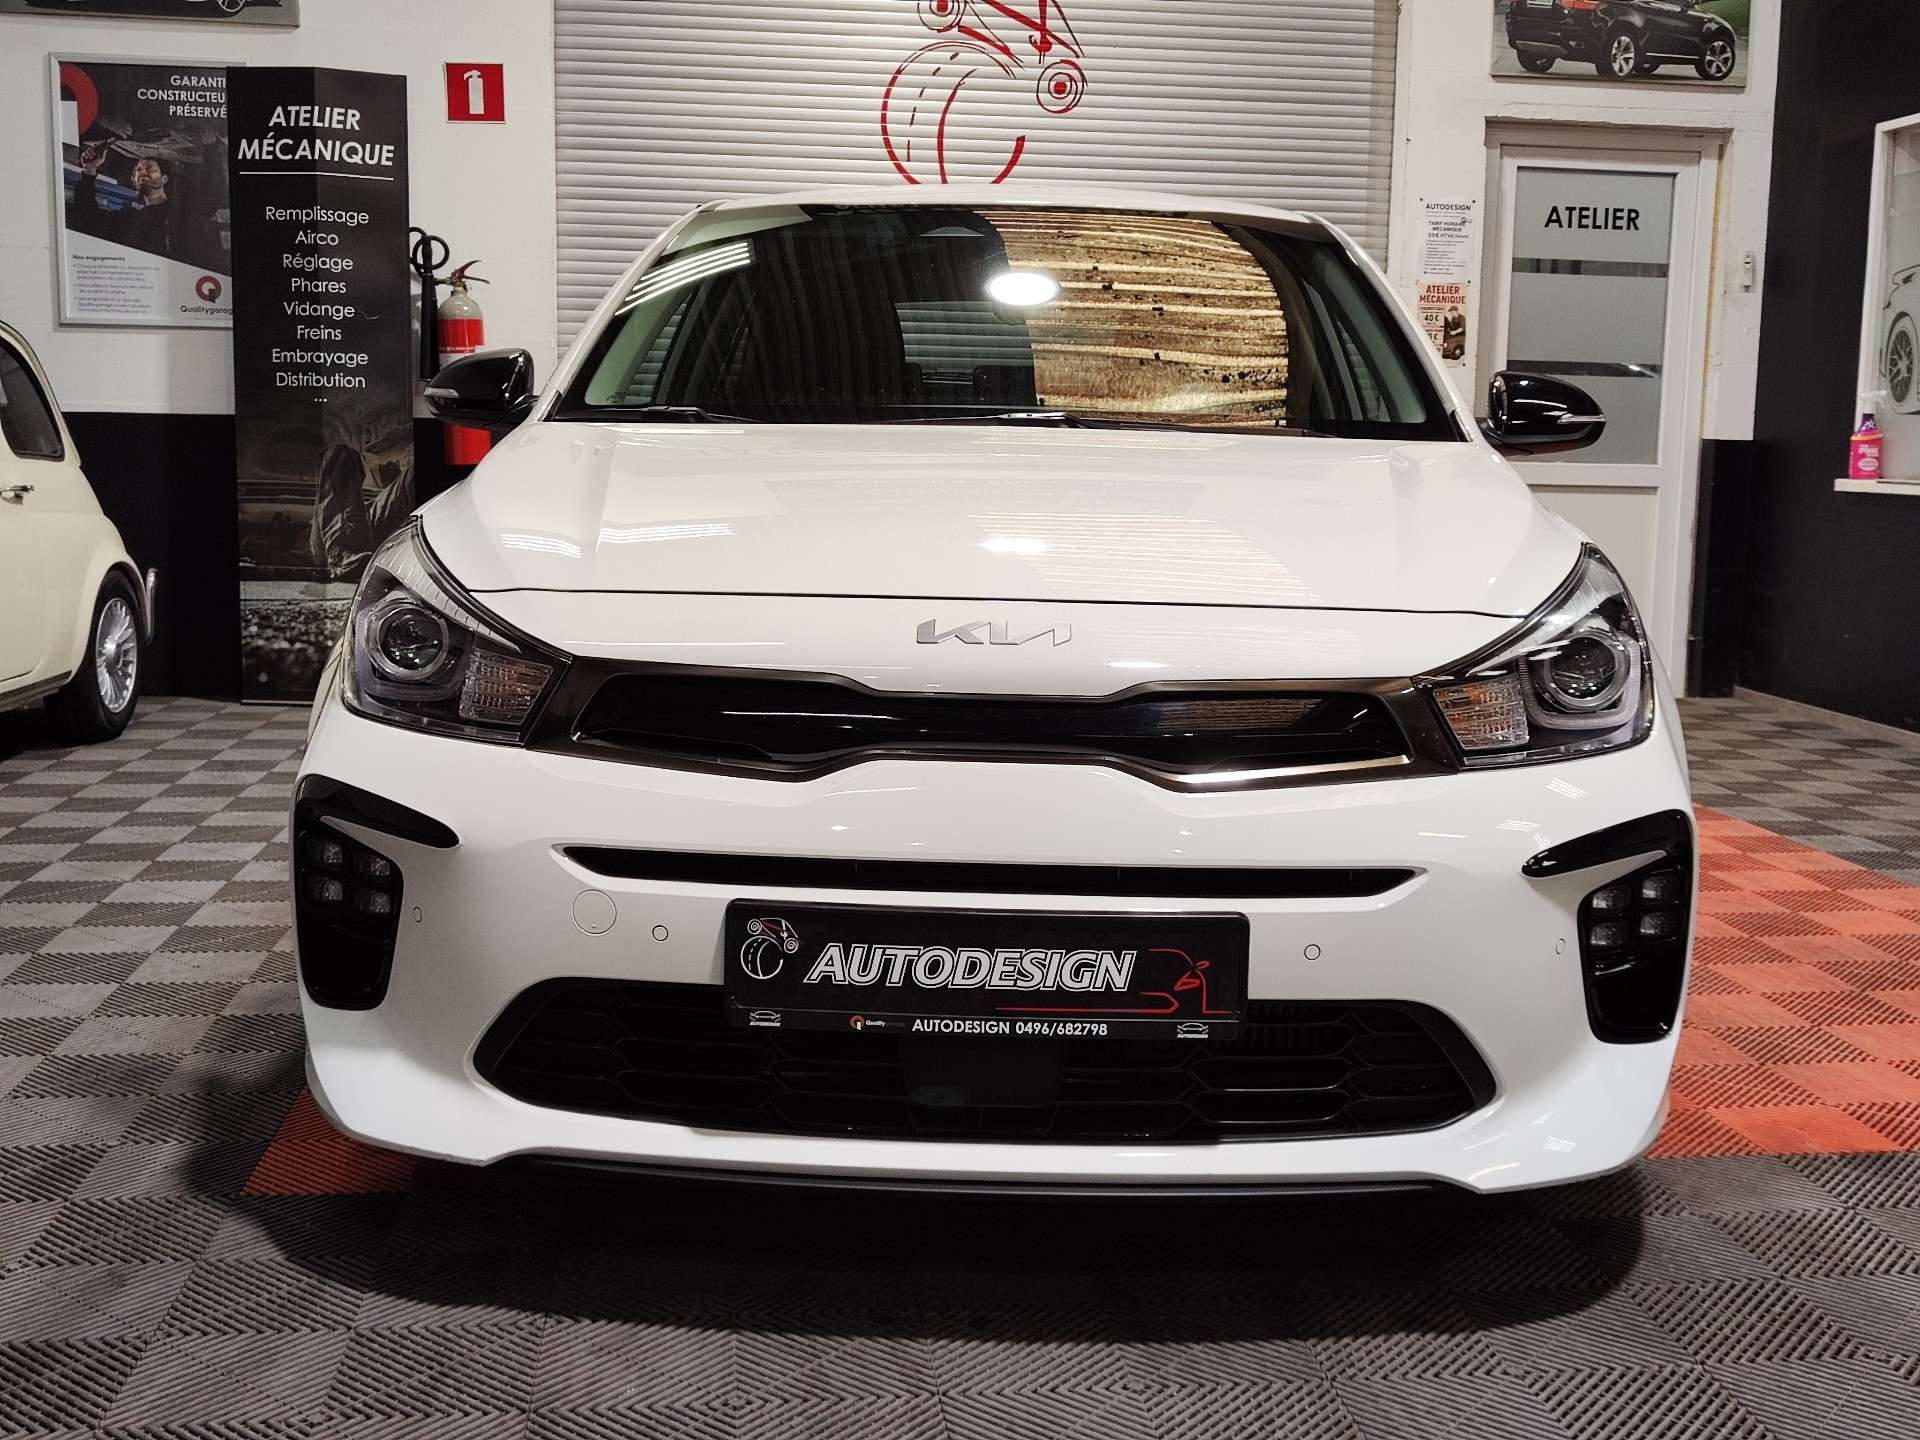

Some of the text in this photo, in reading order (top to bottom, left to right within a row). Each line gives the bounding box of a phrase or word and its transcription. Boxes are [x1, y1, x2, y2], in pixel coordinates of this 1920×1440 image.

[170, 75, 226, 88] GARANTI
[137, 89, 226, 103] CONSTRUCTEU
[169, 102, 228, 118] PRÉSERVÉ
[268, 105, 361, 131] ATELIER
[237, 131, 395, 166] MÉCANIQUE
[1425, 203, 1472, 211] AUTODESIGN
[265, 205, 370, 227] Remplissage
[1543, 205, 1640, 231] ATELIER
[295, 229, 339, 246] Airco
[282, 252, 354, 273] Réglage
[291, 277, 347, 293] Phares
[1425, 285, 1461, 295] ATELIER
[1419, 294, 1466, 304] MÉCANIQUE
[180, 304, 233, 315] Qualitygarag
[283, 301, 356, 320] Vidange
[297, 325, 342, 340] Freins
[272, 348, 369, 367] Embrayage
[276, 371, 366, 388] Distribution
[803, 942, 1138, 992] AUTODESIGN
[911, 1018, 1108, 1037] AUTODESIGN 0496/682798
